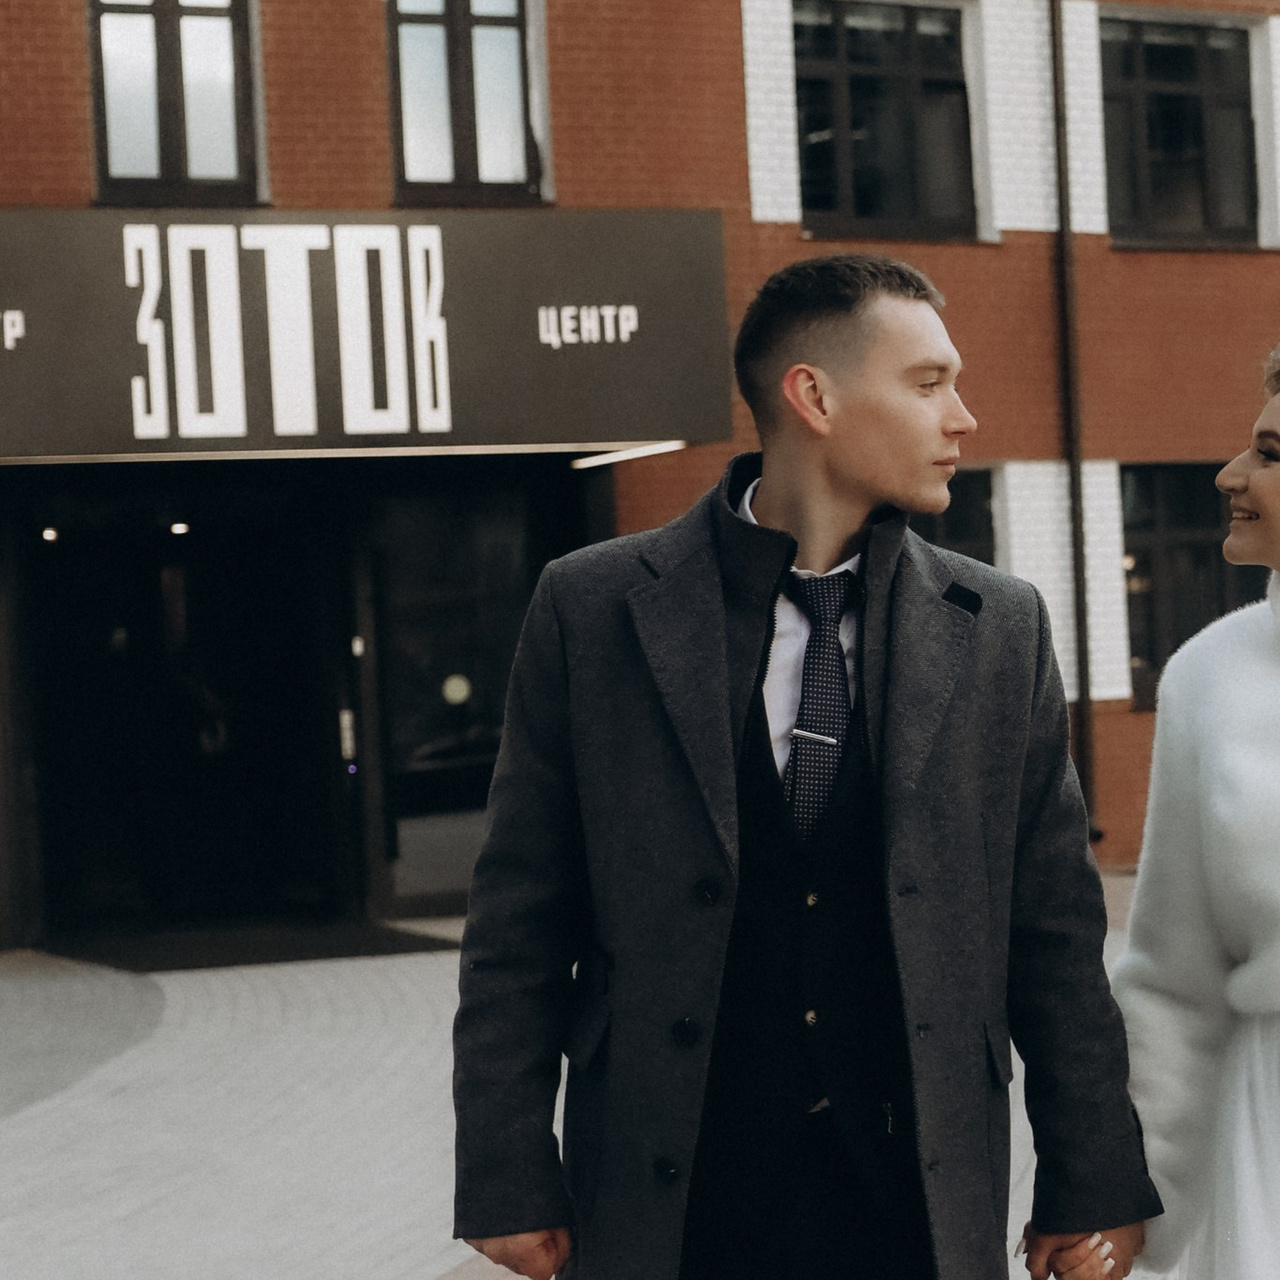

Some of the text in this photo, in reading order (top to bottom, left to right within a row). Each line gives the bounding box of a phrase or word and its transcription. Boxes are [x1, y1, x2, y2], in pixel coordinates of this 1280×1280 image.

[0, 309, 26, 351] Р
[122, 223, 453, 439] ЗОТОВ
[537, 304, 640, 350] ЦЕНТР
